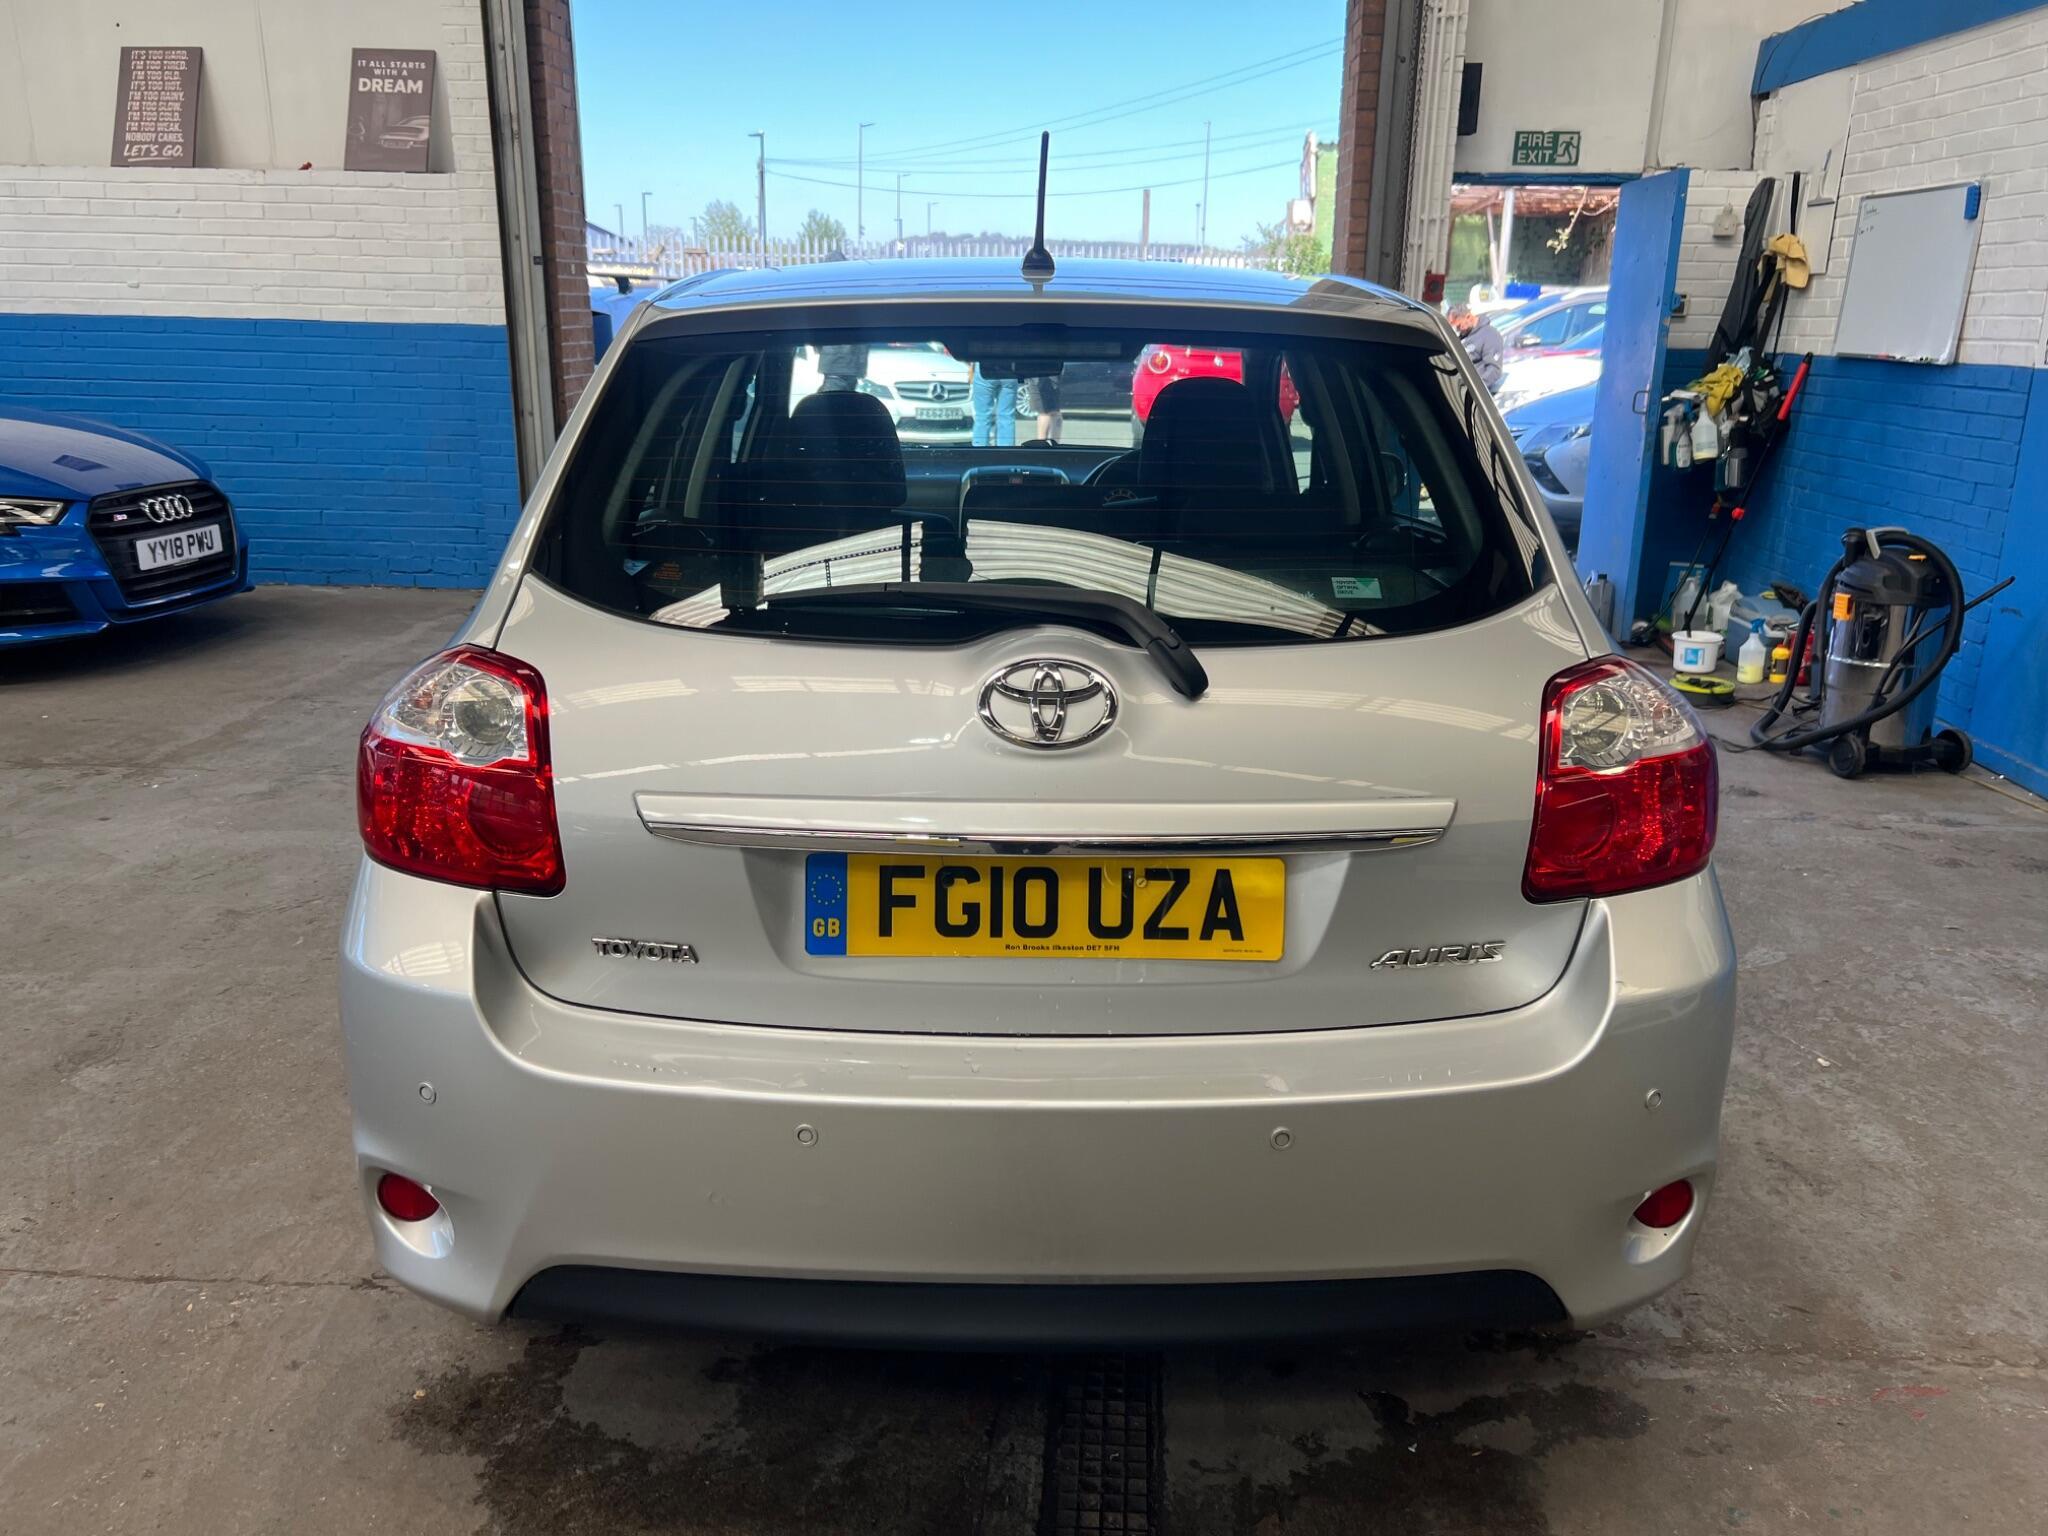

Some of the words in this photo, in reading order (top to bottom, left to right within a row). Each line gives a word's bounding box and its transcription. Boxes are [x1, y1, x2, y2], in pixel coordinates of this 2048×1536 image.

[148, 50, 164, 60] TOO
[146, 60, 161, 70] TOO
[390, 61, 426, 70] STARTS
[147, 70, 162, 80] TOO
[374, 68, 398, 76] WITH
[148, 80, 164, 90] TOO
[358, 78, 423, 94] DREAM
[143, 91, 159, 100] TOO
[142, 101, 158, 111] TOO
[142, 111, 158, 122] TOO
[140, 122, 156, 132] TOO
[125, 132, 156, 142] NOBODY
[1518, 133, 1554, 148] FIRE
[124, 144, 159, 157] LET'S
[162, 144, 184, 157] GO.
[1516, 150, 1553, 164] EXIT
[148, 537, 184, 564] YY18
[187, 529, 214, 556] PWU
[878, 864, 1060, 939] FG10
[1088, 866, 1245, 941] UZA
[813, 917, 840, 938] GB
[591, 938, 700, 964] TOYOTA
[1370, 941, 1506, 970] AURIS
